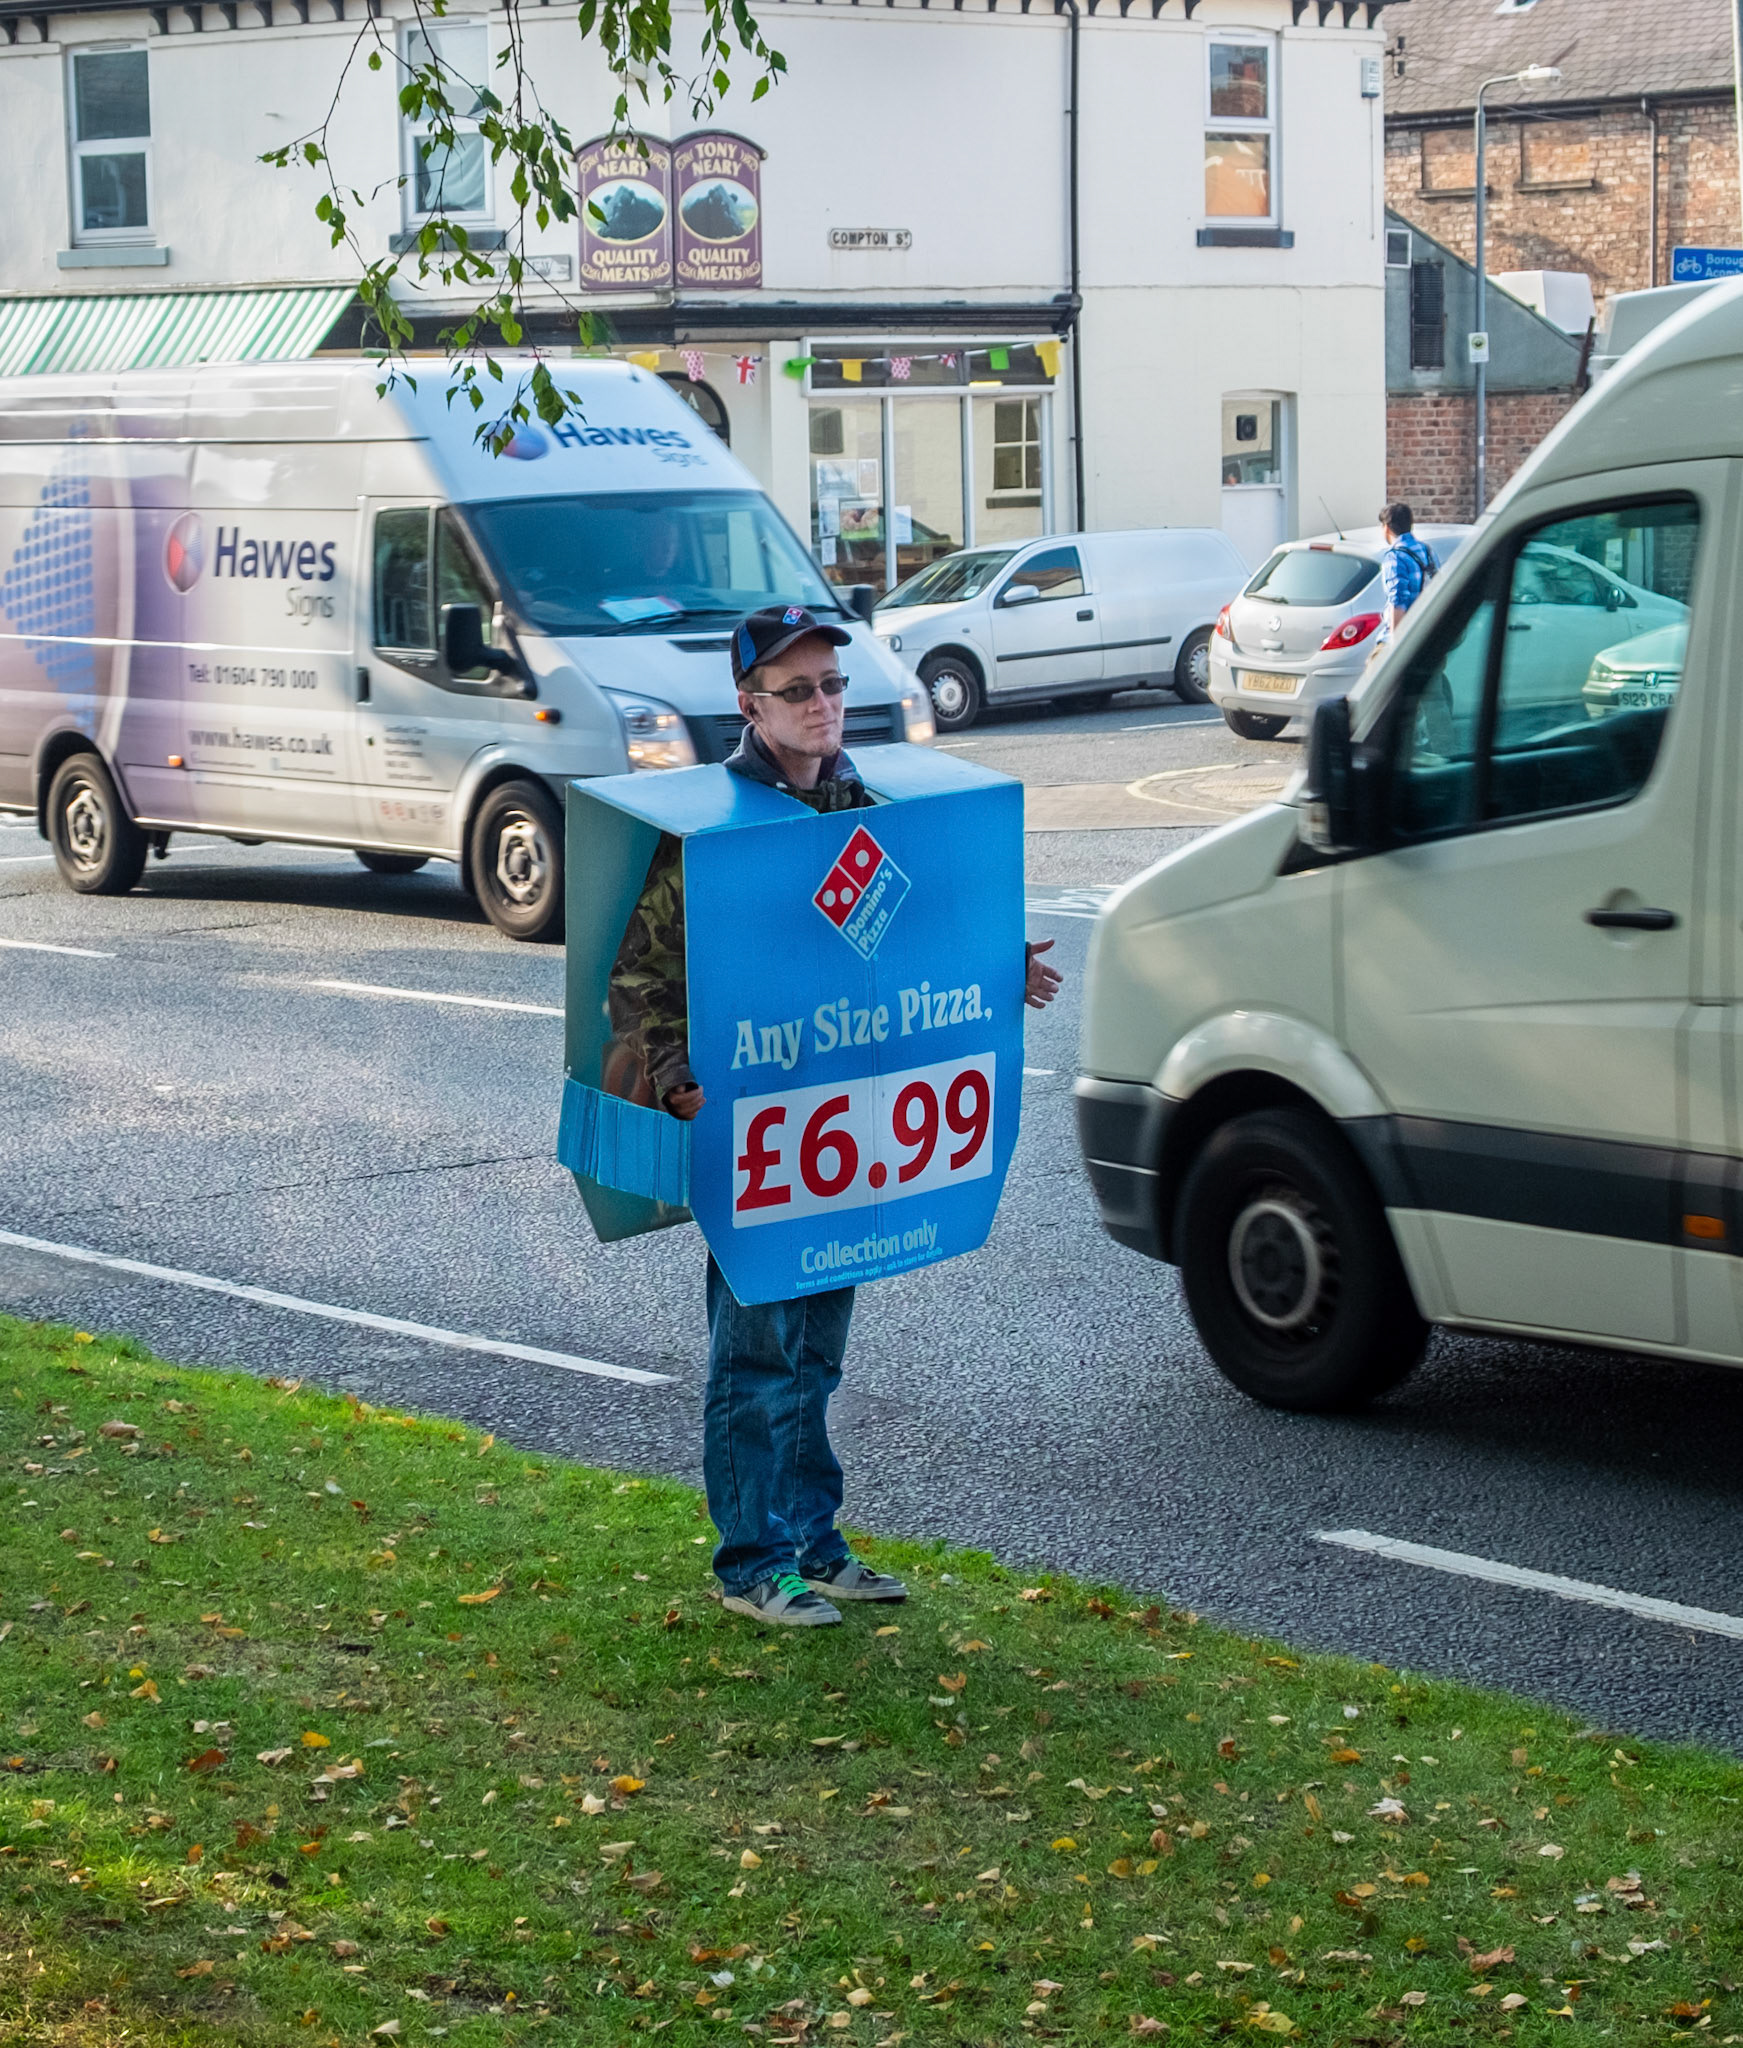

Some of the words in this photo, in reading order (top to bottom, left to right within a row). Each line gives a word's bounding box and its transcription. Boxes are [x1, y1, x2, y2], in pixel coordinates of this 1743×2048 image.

[694, 142, 738, 158] TONY
[596, 158, 649, 179] NEARY
[692, 159, 742, 177] NEARY
[832, 231, 889, 245] COMPTON
[591, 248, 659, 266] QUALITY
[687, 248, 751, 266] QUALITY
[600, 266, 651, 283] MEATS
[699, 265, 743, 281] MEATS
[548, 422, 692, 449] Hawes
[214, 526, 336, 581] Hawes
[285, 585, 335, 626] Signs
[214, 665, 256, 686] 01604
[290, 669, 319, 690] 000
[846, 868, 893, 940] Domino's
[857, 908, 889, 952] Pizza
[730, 1018, 804, 1070] Any
[813, 996, 889, 1054] Size
[898, 980, 993, 1037] Pizza,
[736, 1069, 990, 1212] £6.99
[801, 1232, 900, 1274] Collection
[902, 1218, 938, 1251] only
[816, 1275, 829, 1286] and
